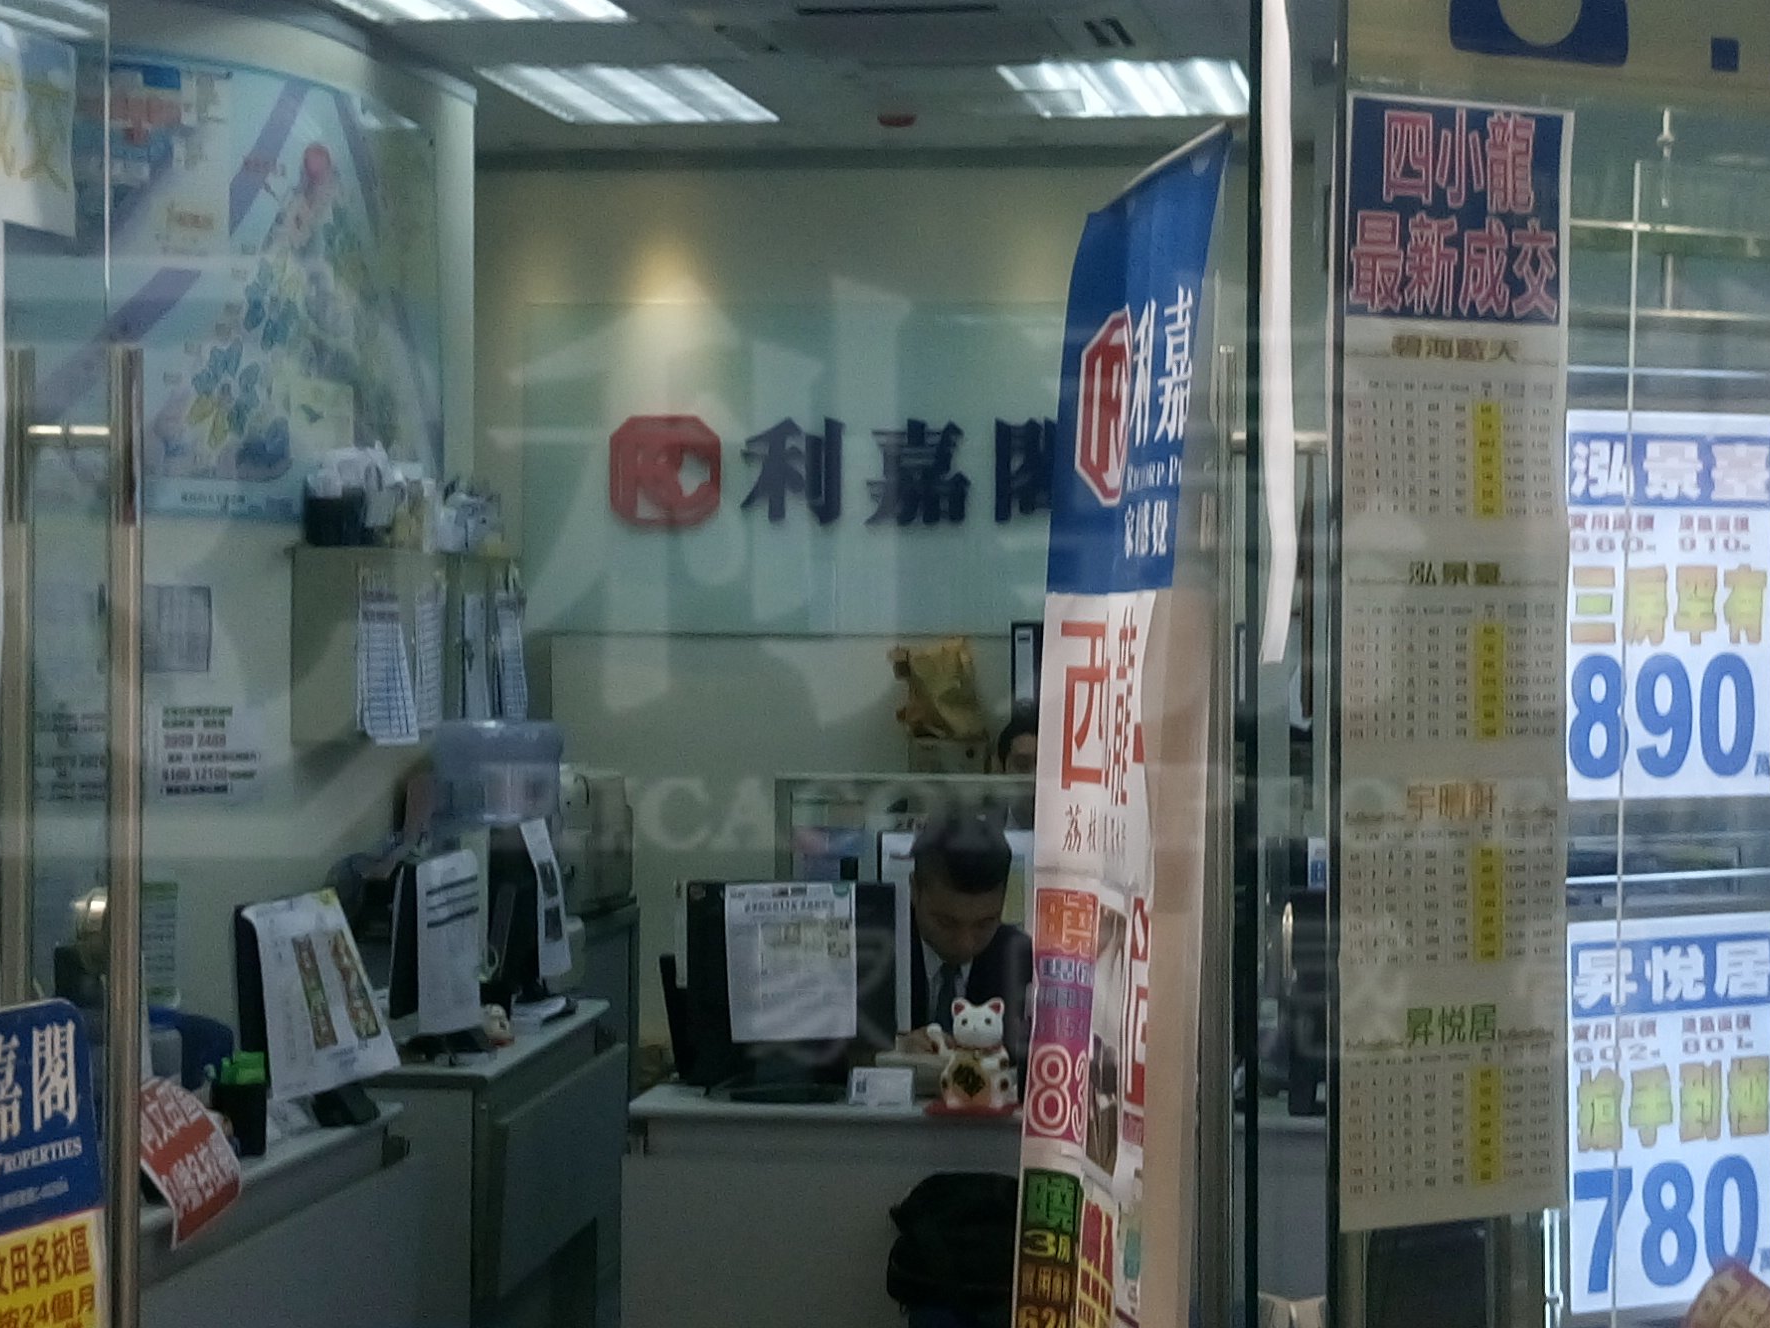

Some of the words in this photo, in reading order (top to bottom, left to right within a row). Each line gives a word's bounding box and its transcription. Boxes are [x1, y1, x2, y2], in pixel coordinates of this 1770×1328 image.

[1382, 108, 1536, 214] 四小龍
[1348, 209, 1558, 321] 最新成交
[1570, 438, 1770, 500] 泓景臺
[1405, 1004, 1498, 1045] 昇悅居
